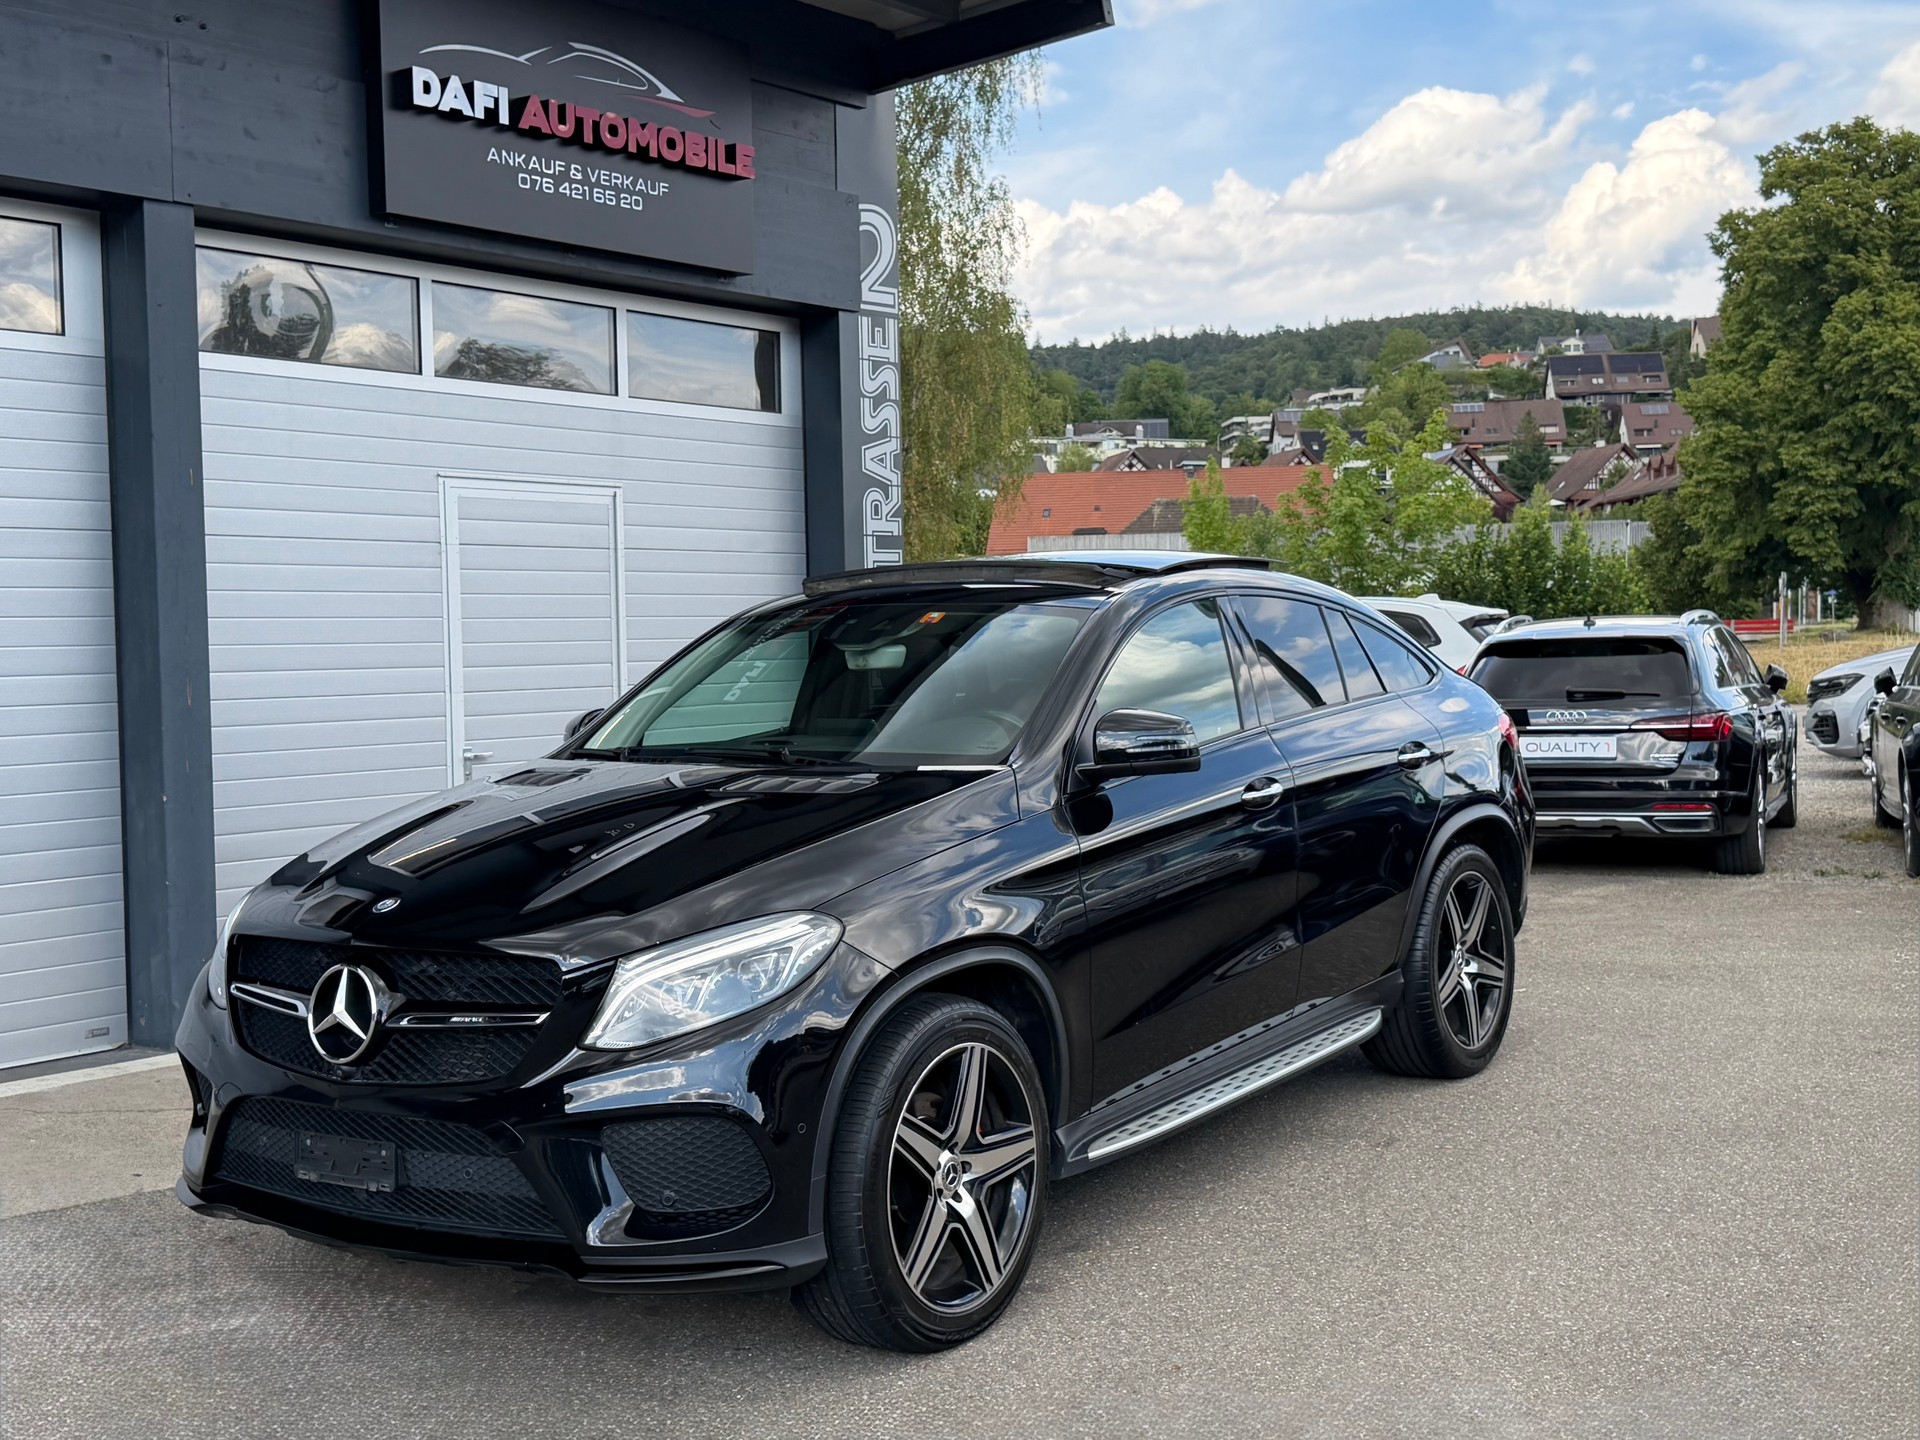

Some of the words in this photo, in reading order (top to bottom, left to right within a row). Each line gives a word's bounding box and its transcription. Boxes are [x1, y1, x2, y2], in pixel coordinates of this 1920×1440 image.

[412, 65, 510, 126] DAFI
[518, 94, 756, 180] AUTOMOBILE
[487, 147, 566, 176] ANKAUF
[569, 163, 583, 180] &
[586, 166, 670, 197] VERKAUF
[518, 172, 555, 194] 076
[558, 182, 590, 201] 421
[593, 187, 616, 206] 65
[620, 193, 643, 211] 20
[1525, 741, 1601, 753] QUALITY
[1604, 741, 1611, 753] 1
